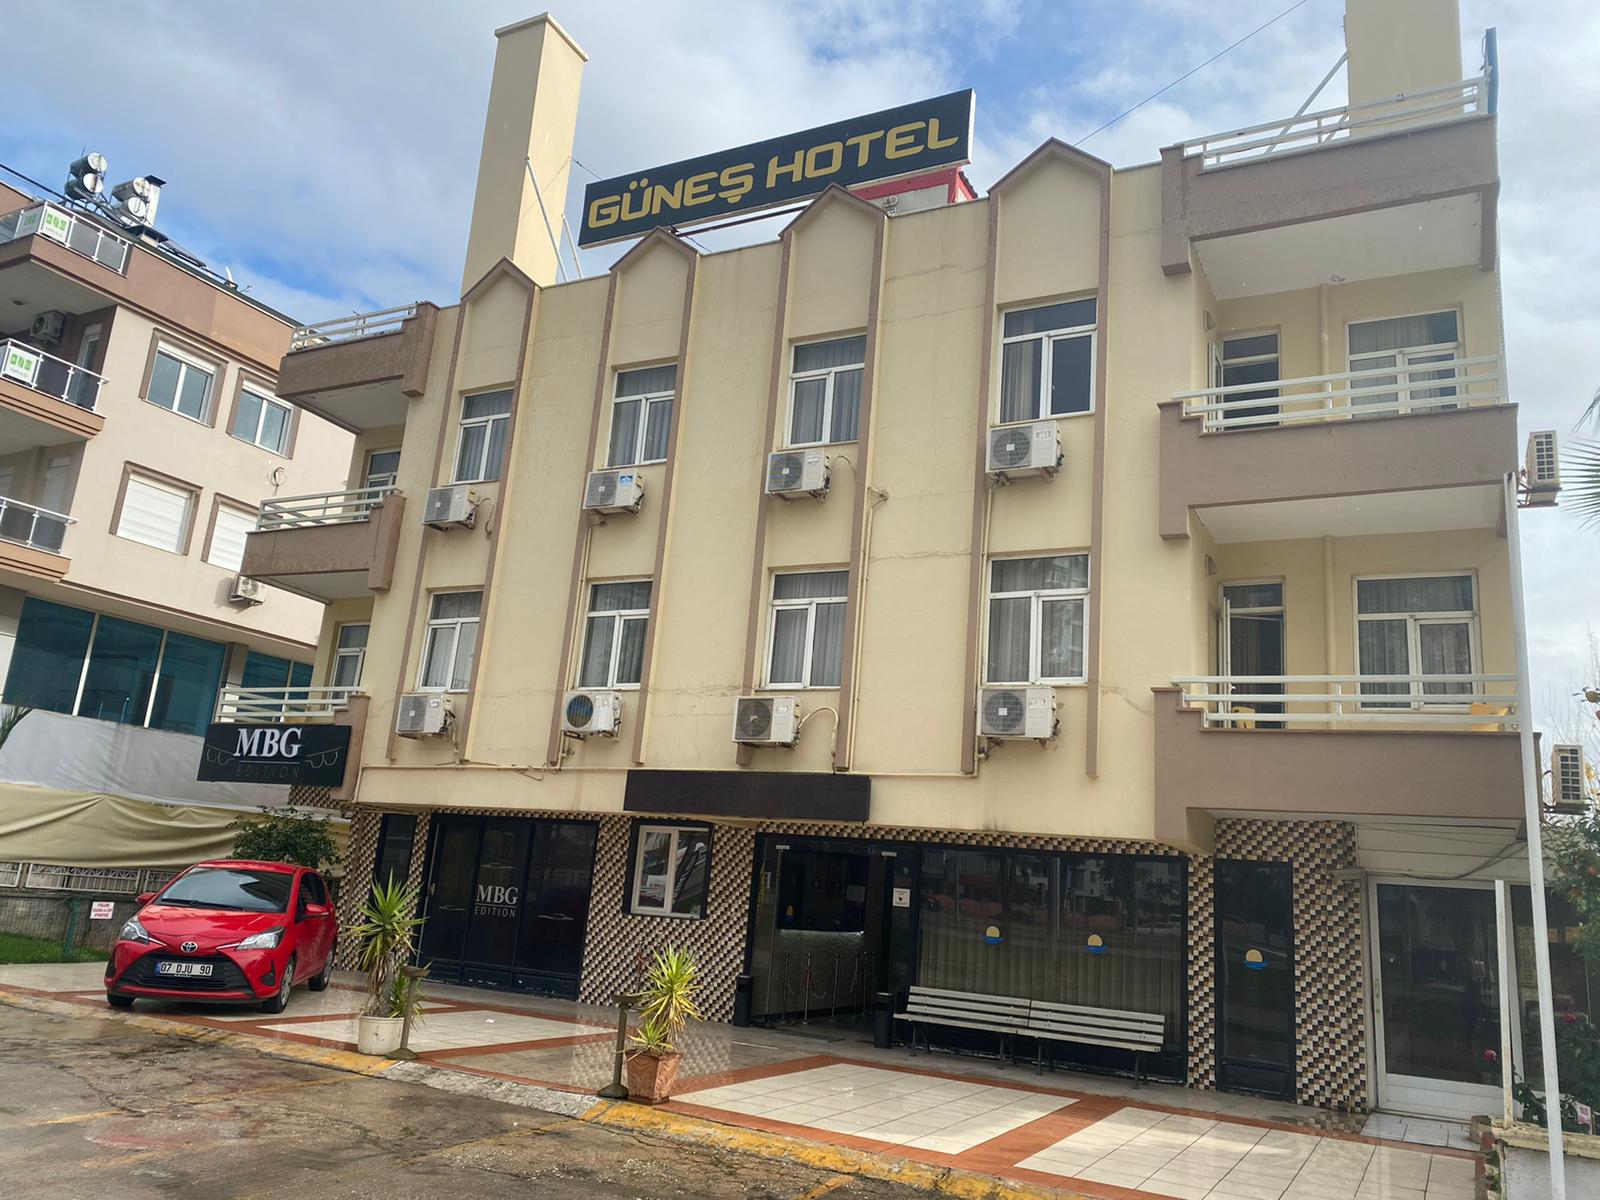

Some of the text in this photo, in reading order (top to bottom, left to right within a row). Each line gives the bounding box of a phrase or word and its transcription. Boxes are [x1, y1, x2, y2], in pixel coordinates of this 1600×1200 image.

[587, 117, 959, 229] GÜNEŞ HOTEL
[233, 727, 303, 758] MBG
[235, 765, 300, 779] EDITION
[476, 884, 519, 905] MBG
[474, 905, 516, 918] EDITION
[160, 963, 172, 973] 07
[199, 965, 211, 975] 90
